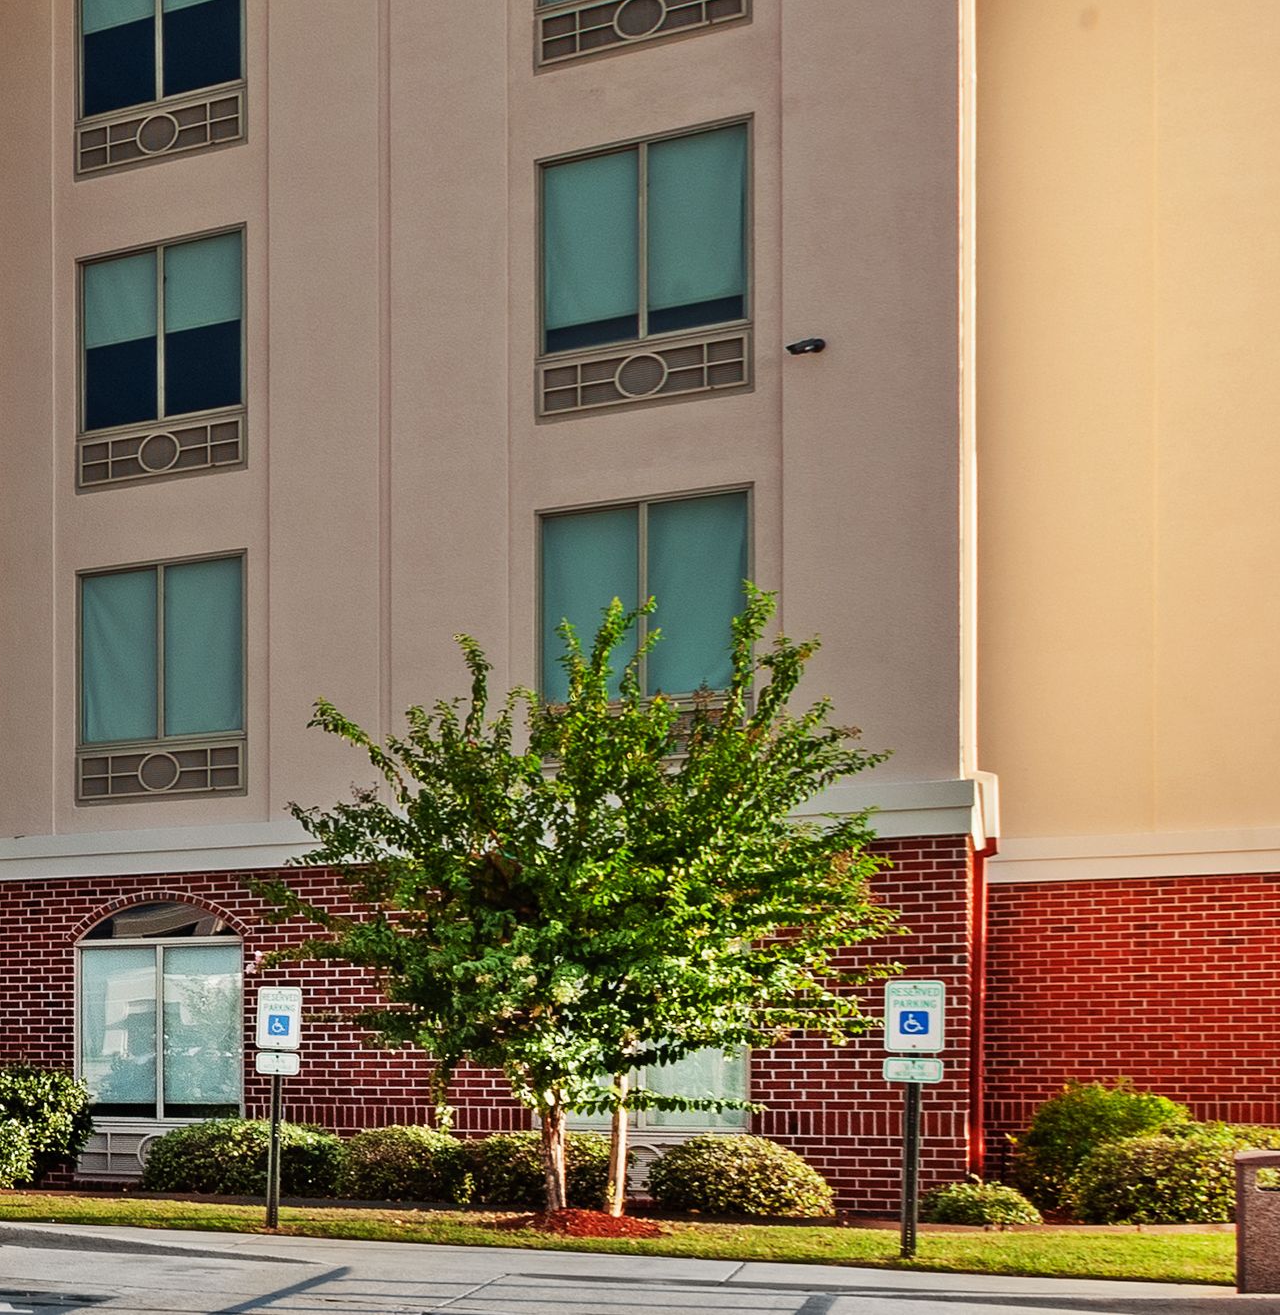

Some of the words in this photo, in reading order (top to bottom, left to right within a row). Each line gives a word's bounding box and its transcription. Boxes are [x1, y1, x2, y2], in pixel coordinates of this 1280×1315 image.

[890, 987, 940, 997] RESERVED
[262, 993, 299, 1002] RESERVED
[263, 1004, 296, 1012] PARKING
[893, 999, 937, 1008] PARKING
